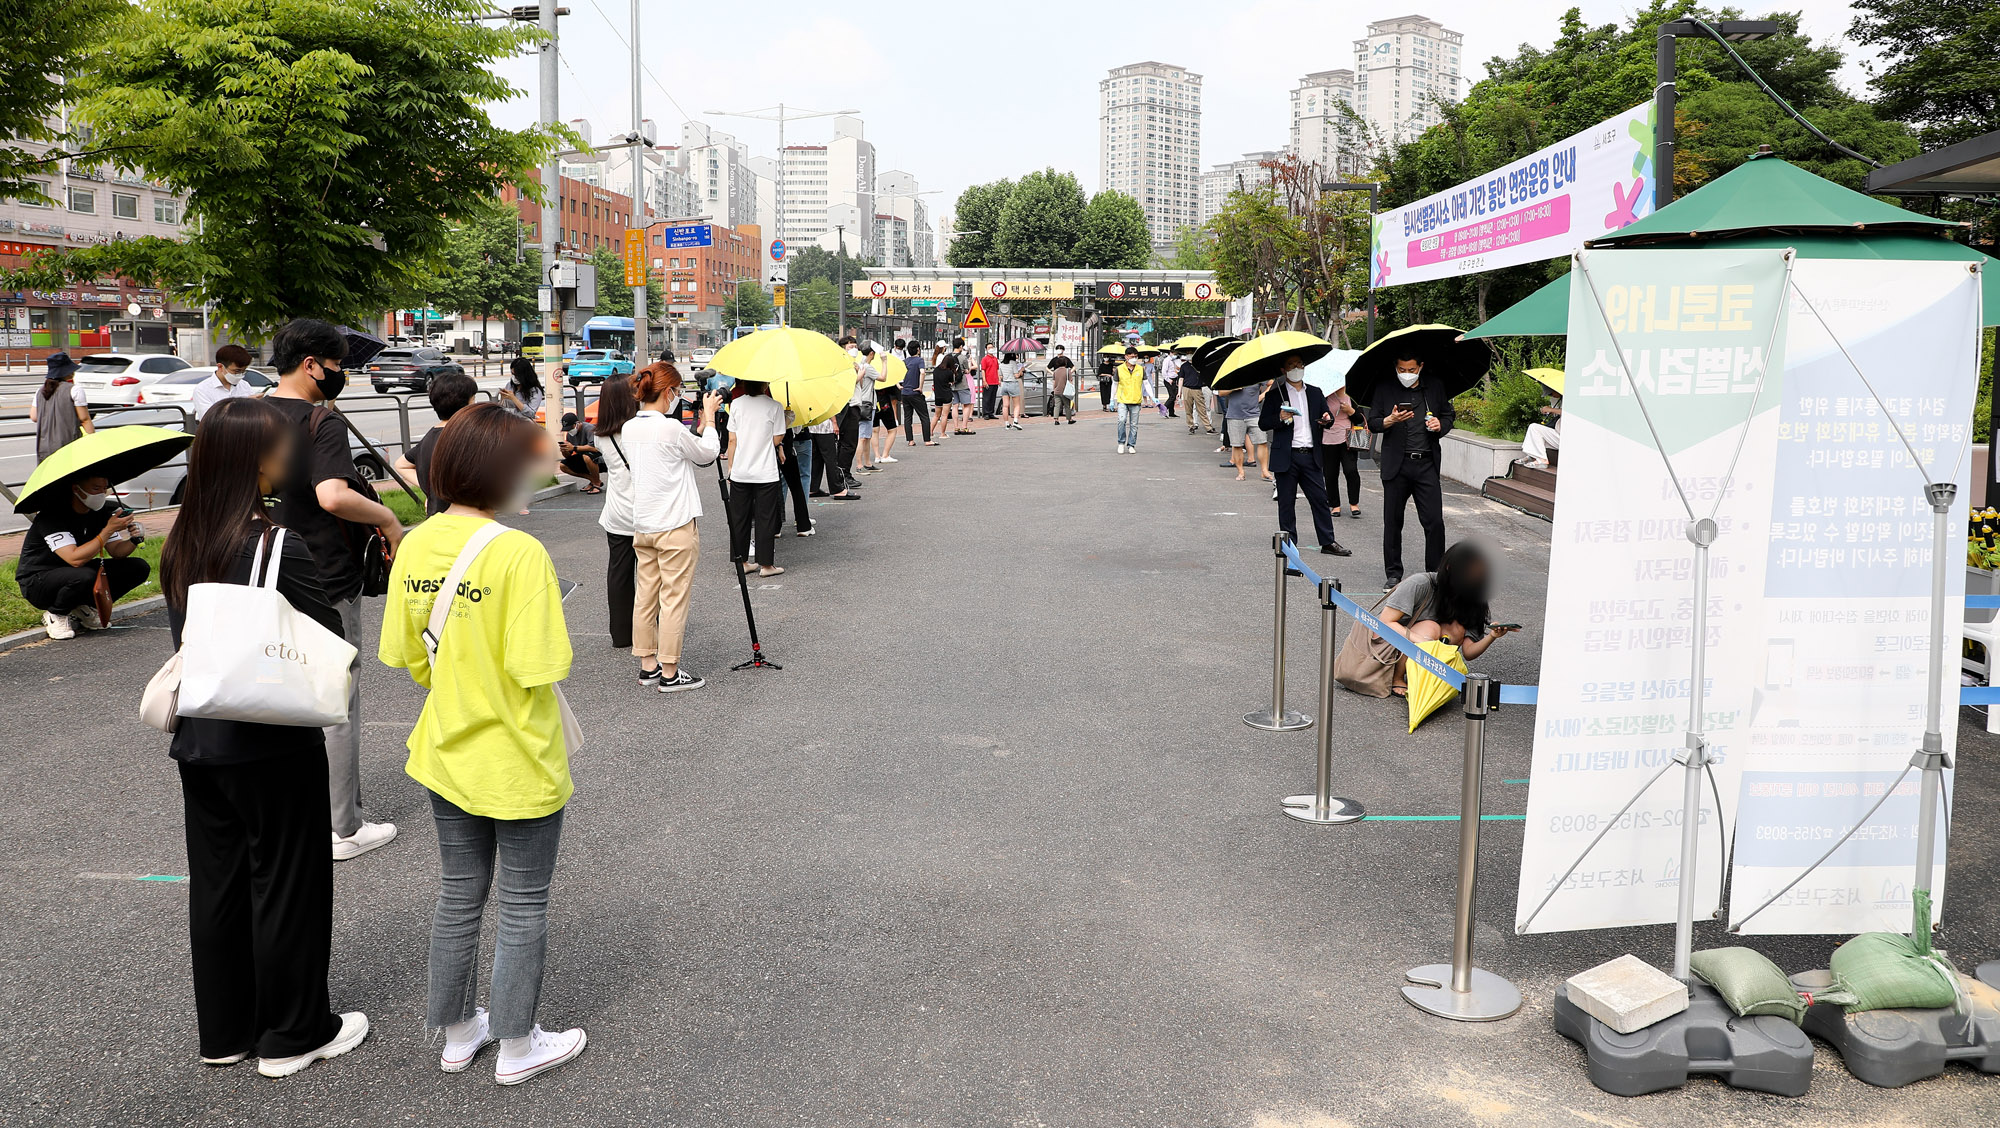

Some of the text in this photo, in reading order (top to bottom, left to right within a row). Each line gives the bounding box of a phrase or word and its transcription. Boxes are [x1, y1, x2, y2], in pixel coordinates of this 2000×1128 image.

[1602, 129, 1617, 150] 서초구
[857, 155, 867, 192] DongAh
[1404, 146, 1577, 237] 임시선별검사소 아래 기간 동안 연장운영 안내
[890, 285, 932, 294] 택시하차
[1011, 284, 1052, 296] 택시승차
[1128, 286, 1171, 296] 모범택시
[1423, 655, 1447, 677] 서초구보건소
